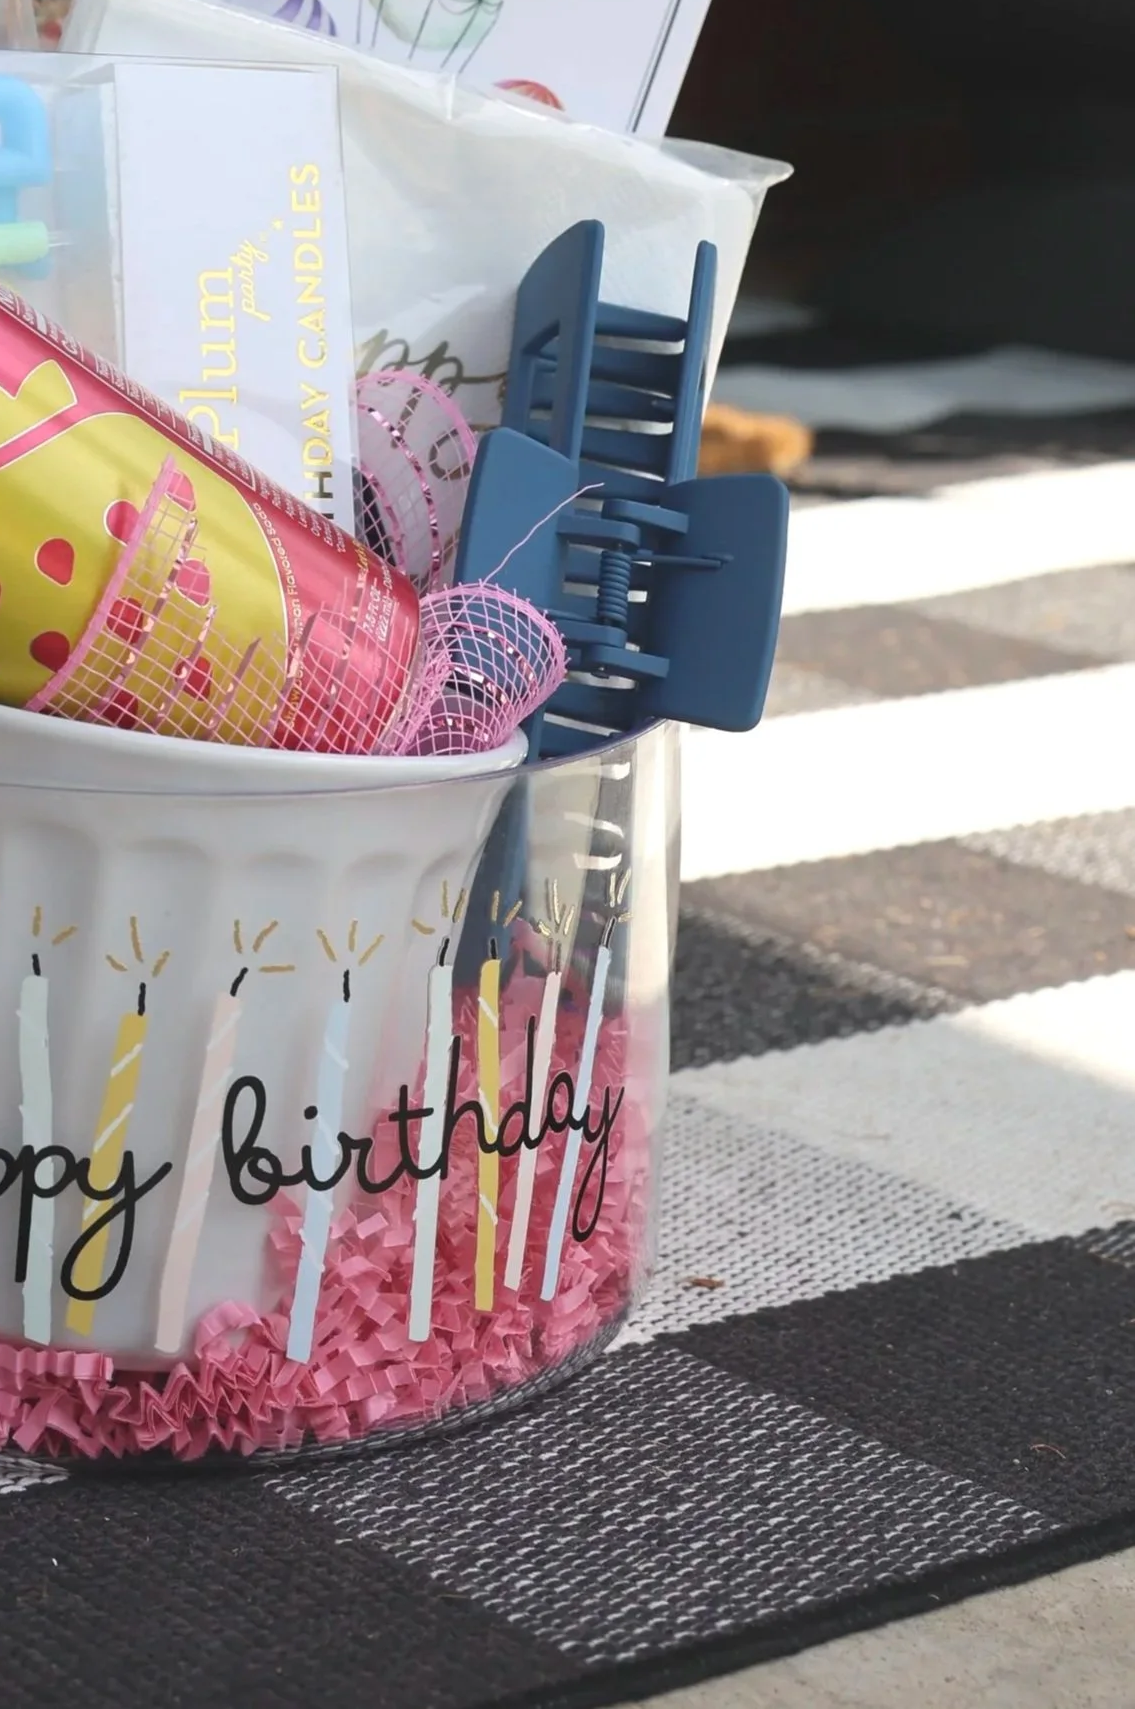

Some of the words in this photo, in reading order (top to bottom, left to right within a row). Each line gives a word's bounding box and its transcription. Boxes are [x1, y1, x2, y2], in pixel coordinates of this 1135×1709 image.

[230, 239, 271, 321] party
[290, 162, 328, 370] CANDLES
[221, 1015, 624, 1242] birthday
